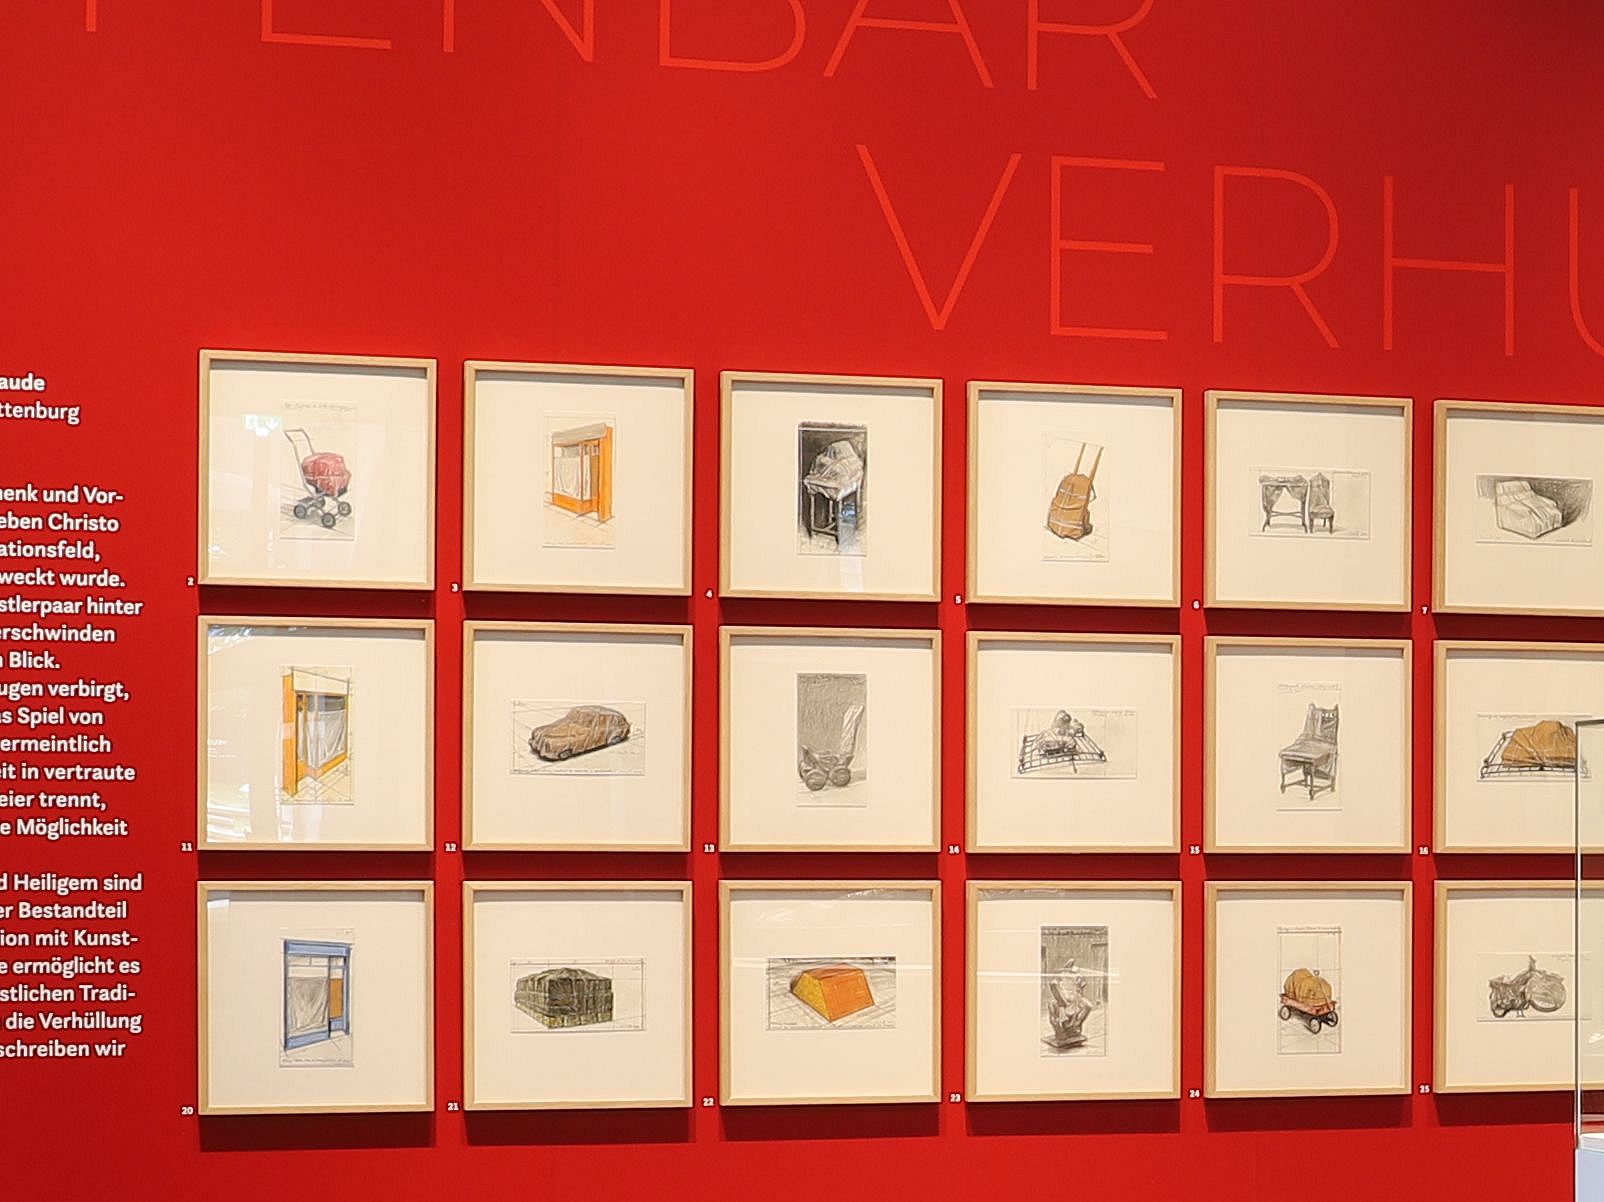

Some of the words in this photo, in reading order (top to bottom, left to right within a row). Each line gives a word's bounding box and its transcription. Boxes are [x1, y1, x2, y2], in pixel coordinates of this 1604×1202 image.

[0, 373, 45, 390] aude
[43, 485, 78, 502] und
[83, 487, 123, 503] Vor-
[0, 511, 42, 529] eben
[49, 513, 118, 531] Christo
[0, 540, 100, 561] ationsfeld,
[0, 568, 55, 585] weckt
[60, 569, 125, 586] wurde.
[0, 595, 83, 617] stlerpaar
[87, 597, 143, 614] hinter
[10, 651, 59, 668] Blick.
[48, 679, 128, 701] verbirgt,
[18, 707, 64, 728] Spiel
[69, 712, 102, 724] von
[0, 735, 110, 752] ermeintlich
[22, 763, 38, 779] in
[44, 765, 135, 780] vertraute
[0, 791, 34, 807] eier
[39, 792, 105, 810] trennt,
[17, 818, 127, 840] Möglichkeit
[14, 873, 97, 895] Heiligem
[104, 874, 141, 890] sind
[19, 901, 126, 918] Bestandteil
[0, 930, 29, 946] ion
[36, 930, 68, 945] mit
[75, 930, 137, 945] Kunst-
[13, 956, 114, 978] ermöglicht
[119, 961, 140, 973] es
[0, 984, 74, 1001] stlichen
[79, 984, 135, 1001] Tradi-
[6, 1012, 34, 1029] die
[39, 1011, 141, 1033] Verhüllung
[95, 1040, 125, 1056] wir
